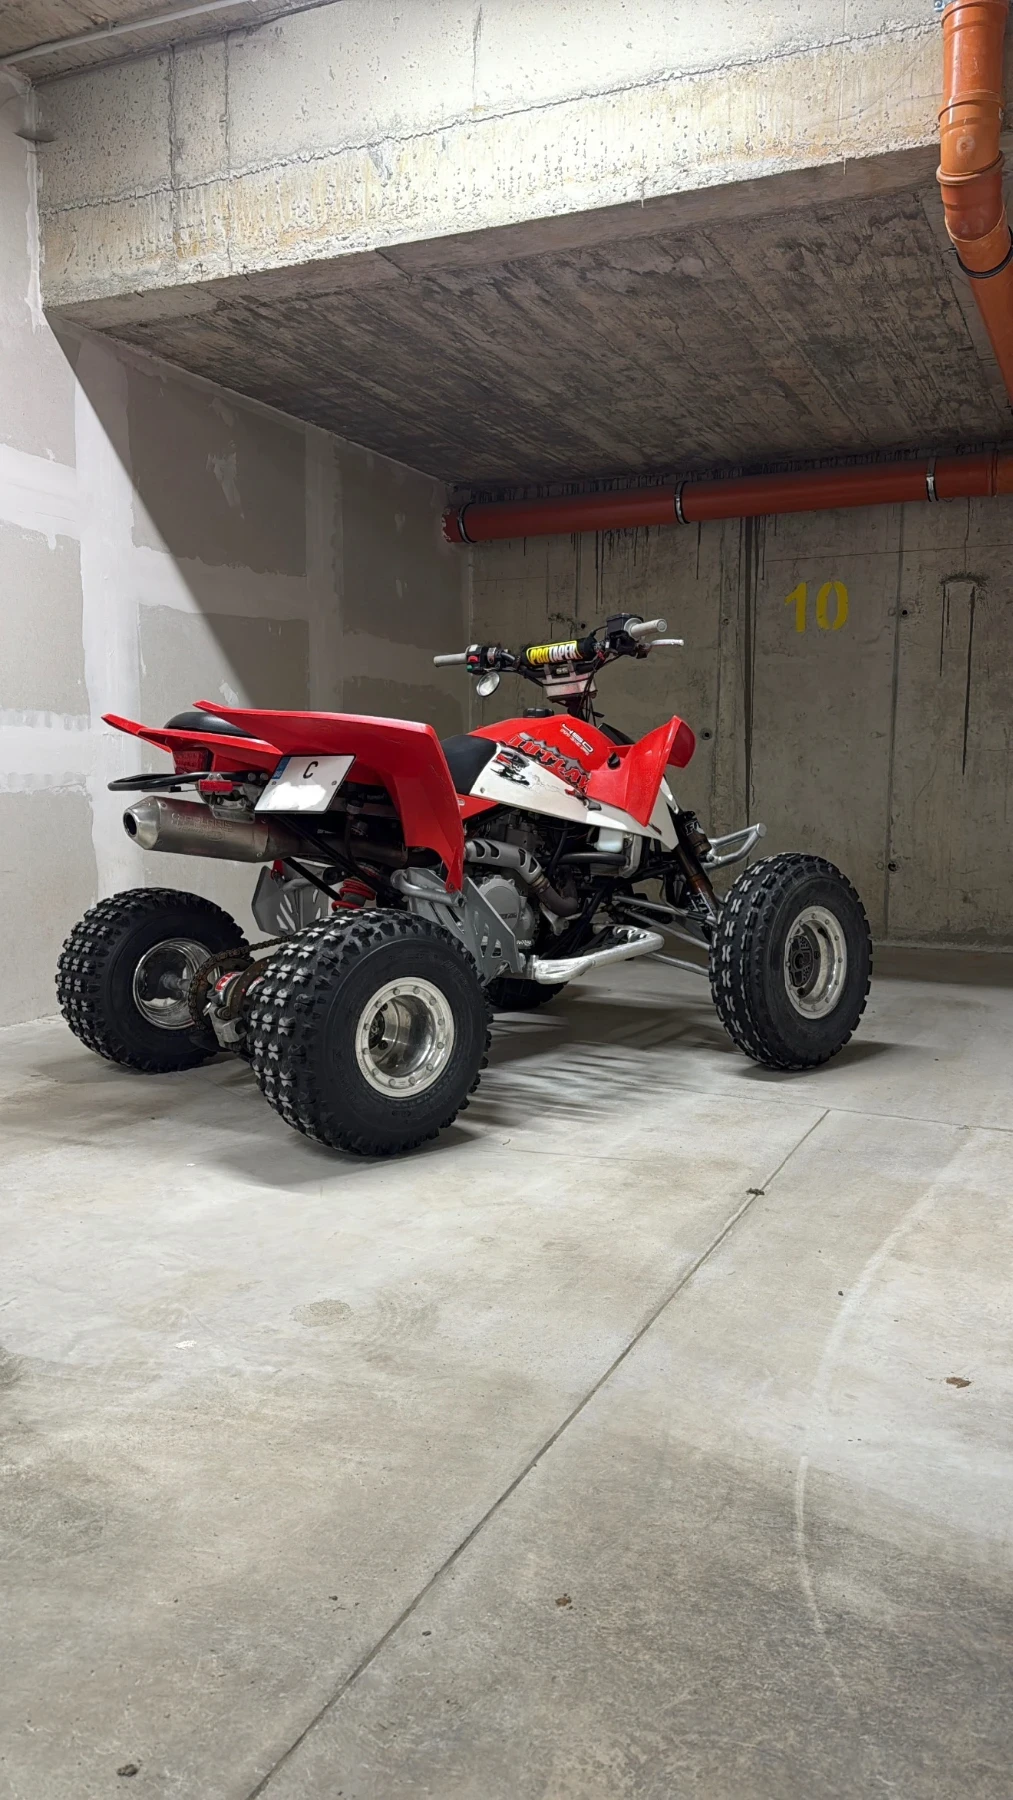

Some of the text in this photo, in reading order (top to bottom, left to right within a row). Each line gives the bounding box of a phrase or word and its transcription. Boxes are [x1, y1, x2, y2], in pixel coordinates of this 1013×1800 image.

[784, 581, 849, 633] 10
[529, 643, 579, 666] PROTAPER
[302, 760, 319, 779] C
